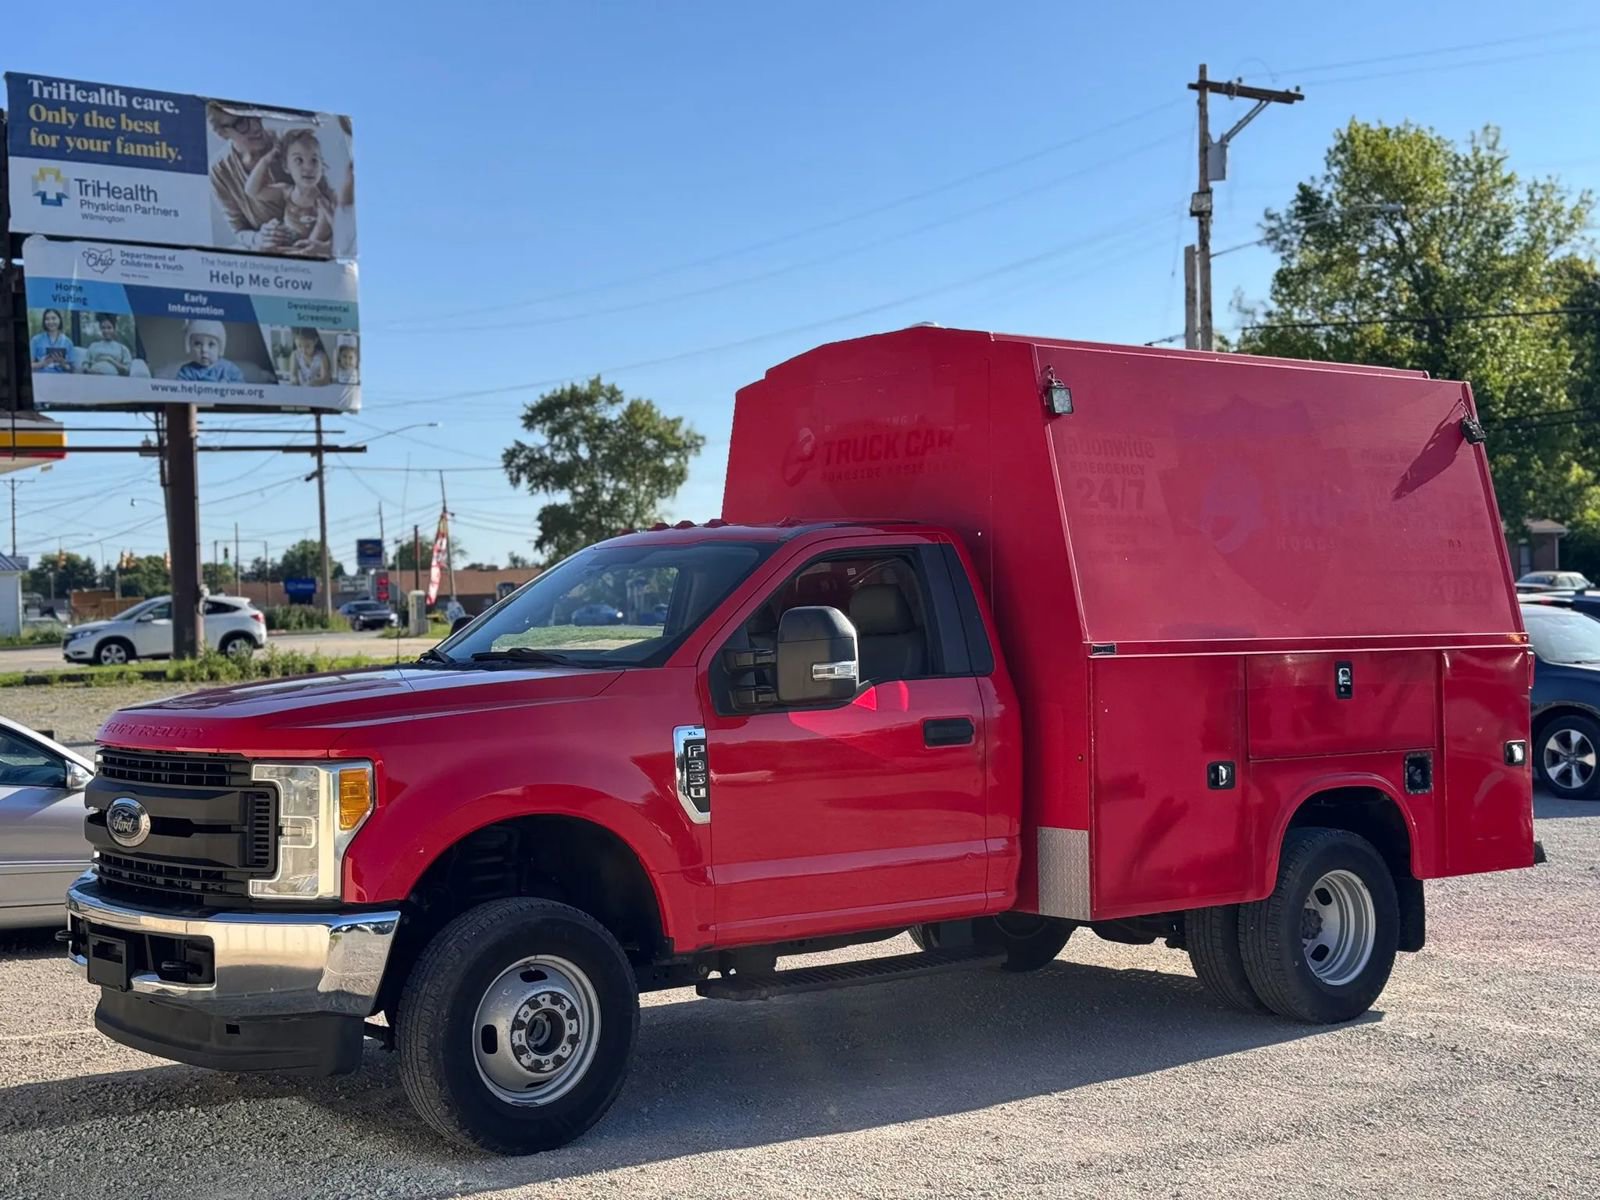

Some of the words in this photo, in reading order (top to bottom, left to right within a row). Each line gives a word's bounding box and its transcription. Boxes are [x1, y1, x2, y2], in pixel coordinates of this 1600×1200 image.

[28, 79, 128, 108] TriHealth
[132, 95, 180, 114] care.
[29, 103, 79, 129] Only
[84, 110, 116, 130] the
[121, 113, 161, 135] best
[30, 128, 60, 148] for
[65, 135, 111, 153] your
[116, 137, 182, 163] family.
[74, 178, 158, 203] TriHealth
[80, 199, 132, 213] Physician
[134, 203, 179, 217] Partners
[81, 212, 125, 224] Wilmington
[82, 250, 116, 268] Ohio
[120, 250, 166, 261] Department
[201, 257, 215, 265] The
[217, 258, 238, 268] heart
[240, 260, 248, 269] of
[120, 259, 153, 269] Children
[162, 263, 184, 271] Youth
[55, 282, 83, 293] Home
[209, 270, 244, 288] Help
[249, 273, 270, 287] Me
[274, 276, 313, 291] Grow
[52, 294, 88, 306] Visiting
[184, 292, 208, 305] Early
[168, 303, 225, 316] Intervention
[287, 301, 350, 314] Developmental
[297, 313, 342, 325] Screenings
[151, 382, 265, 398] www.helpmegrow.org
[823, 432, 900, 466] TRUCK
[1076, 477, 1146, 510] 24/7
[104, 721, 151, 738] SUPER
[687, 744, 707, 798] F350
[113, 809, 134, 833] Ford
